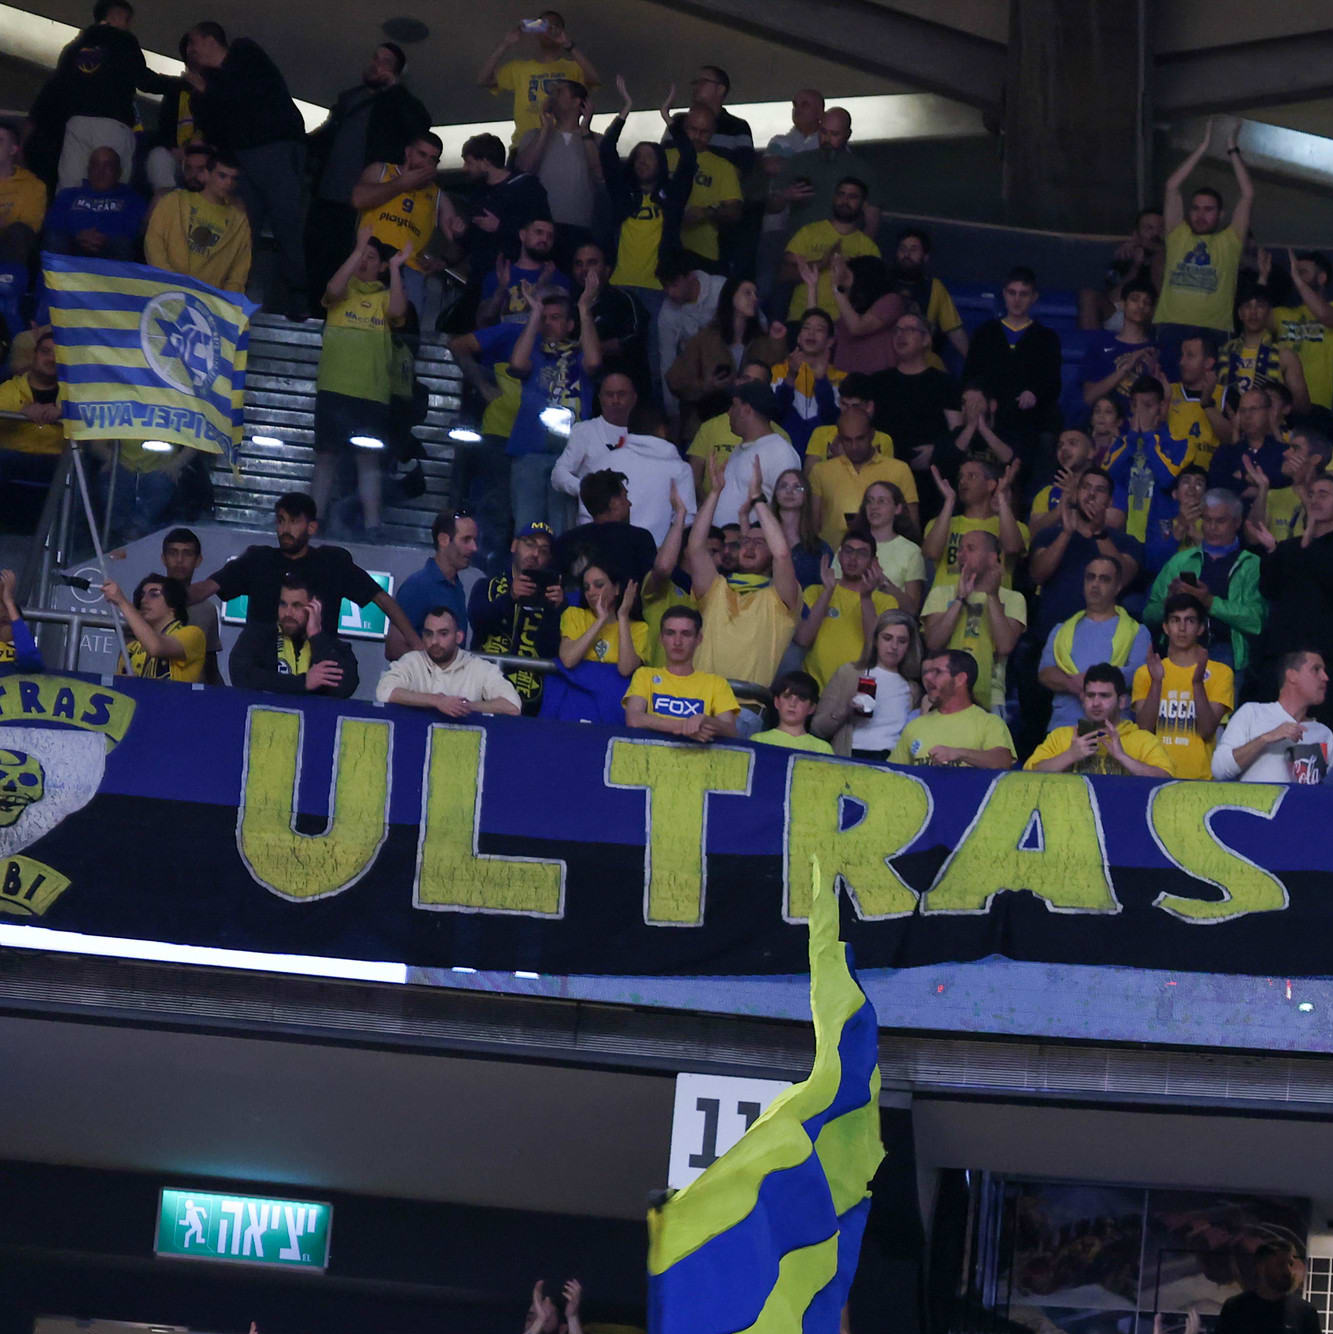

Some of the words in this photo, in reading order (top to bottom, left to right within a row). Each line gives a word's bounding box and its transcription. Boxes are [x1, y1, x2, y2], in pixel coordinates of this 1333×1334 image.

[402, 198, 415, 214] 9
[80, 634, 114, 655] ATE
[654, 697, 701, 716] FOX
[237, 704, 1290, 927] ULTRAS
[215, 1200, 318, 1266] יציאה
